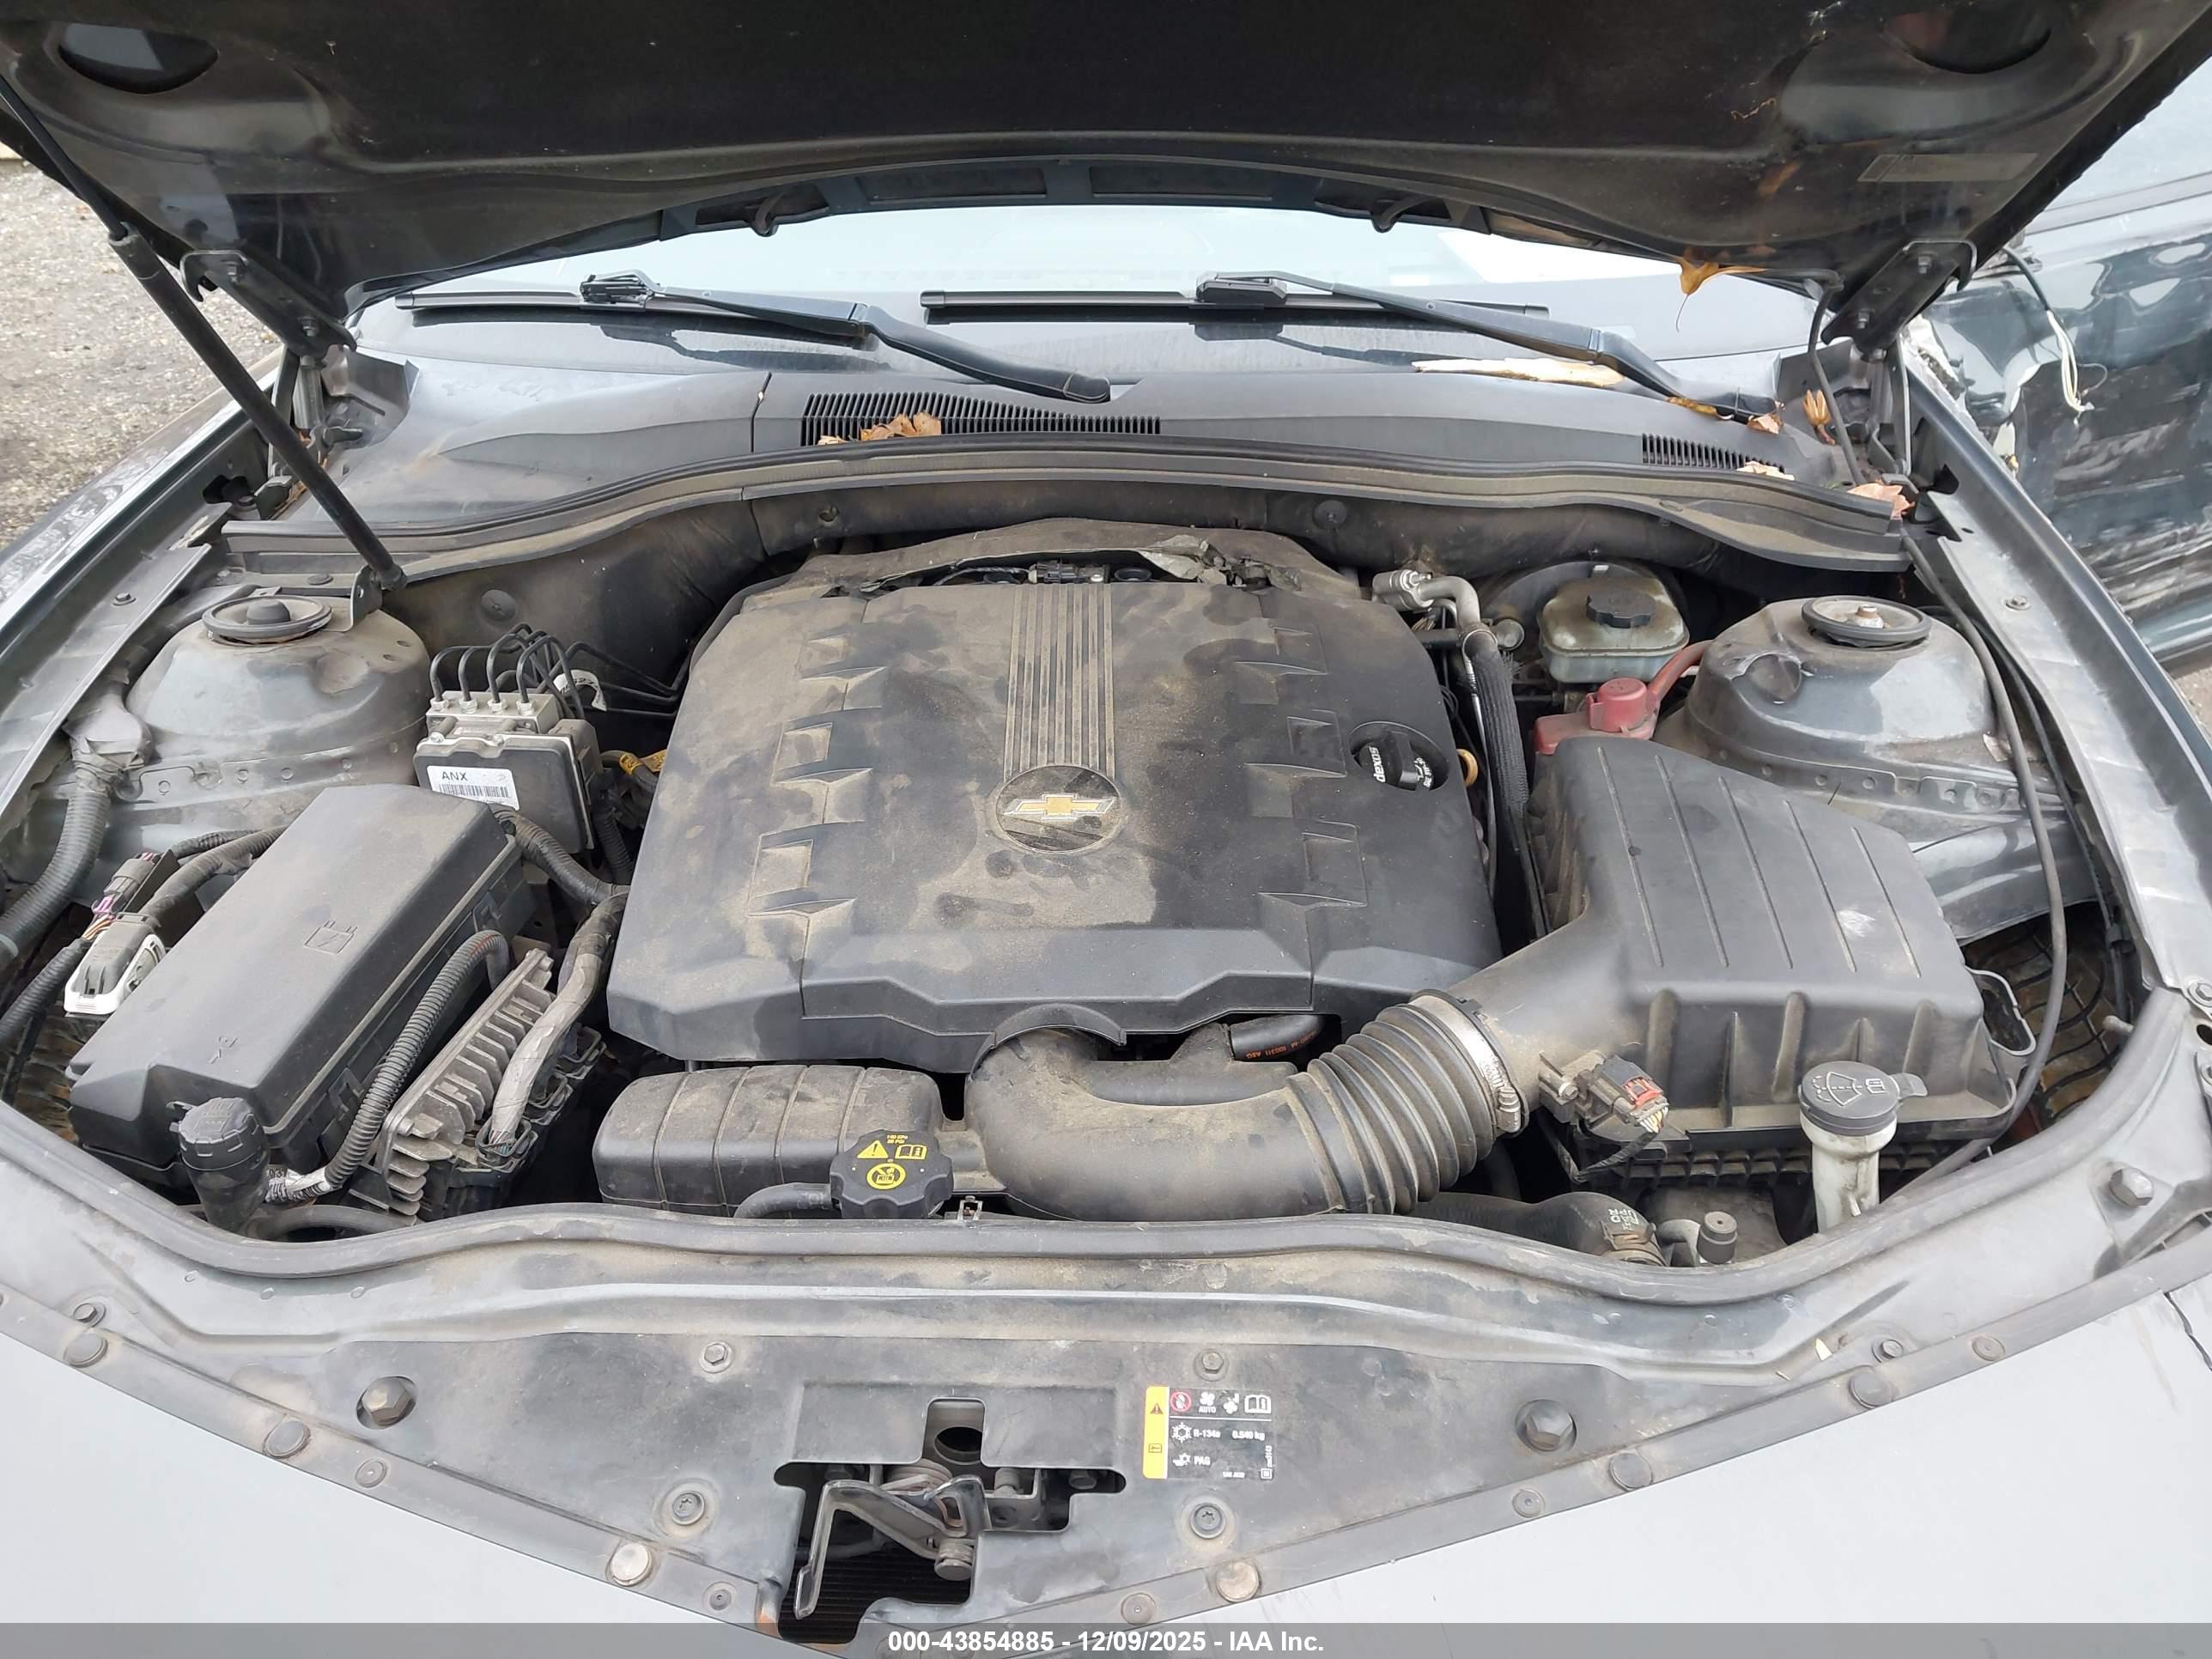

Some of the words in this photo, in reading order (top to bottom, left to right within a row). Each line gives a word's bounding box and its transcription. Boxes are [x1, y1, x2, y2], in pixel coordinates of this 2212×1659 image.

[1368, 744, 1387, 783] dexos
[441, 770, 468, 781] ANX
[1198, 1406, 1217, 1414] AUTO
[1193, 1428, 1221, 1439] R-134a
[1254, 1430, 1266, 1442] kg
[1194, 1455, 1211, 1467] PAG
